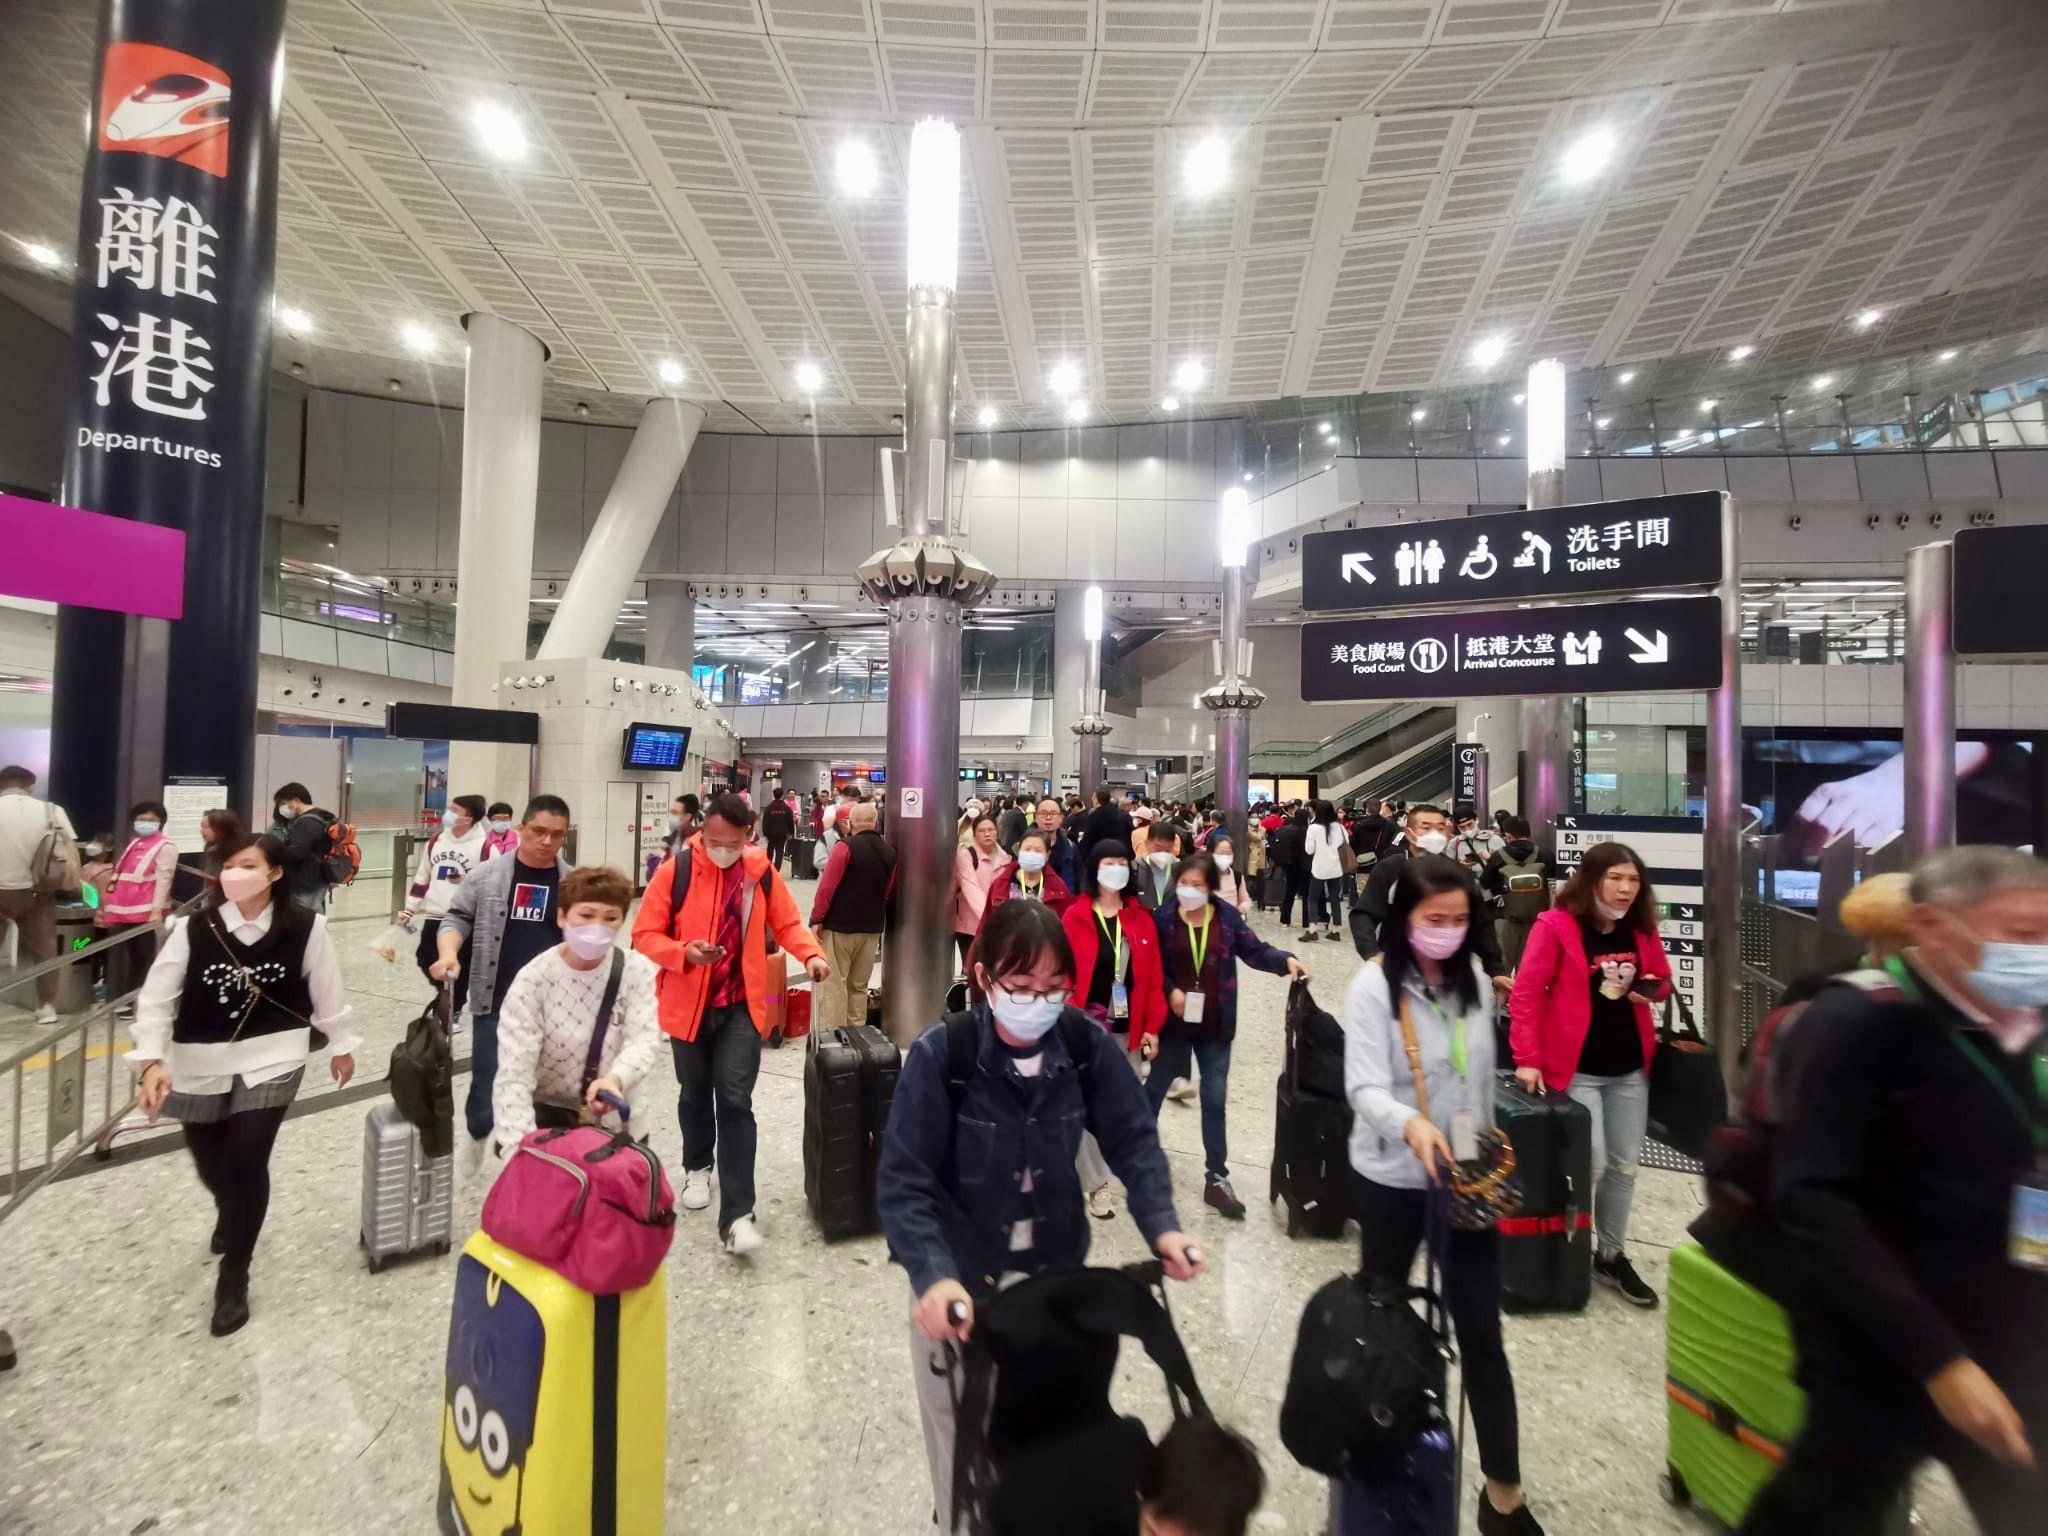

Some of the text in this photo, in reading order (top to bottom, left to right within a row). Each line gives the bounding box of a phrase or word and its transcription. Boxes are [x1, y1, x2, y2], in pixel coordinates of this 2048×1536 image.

[89, 186, 219, 420] 離港
[78, 427, 222, 468] Departures
[1566, 517, 1670, 554] 洗手間
[1567, 556, 1621, 573] Toilets
[1331, 642, 1406, 663] 美食廣場
[1466, 633, 1555, 656] 抵港大堂
[1353, 663, 1405, 674] Food Court
[1464, 656, 1555, 670] Arrival Concourse
[516, 906, 541, 919] NYC
